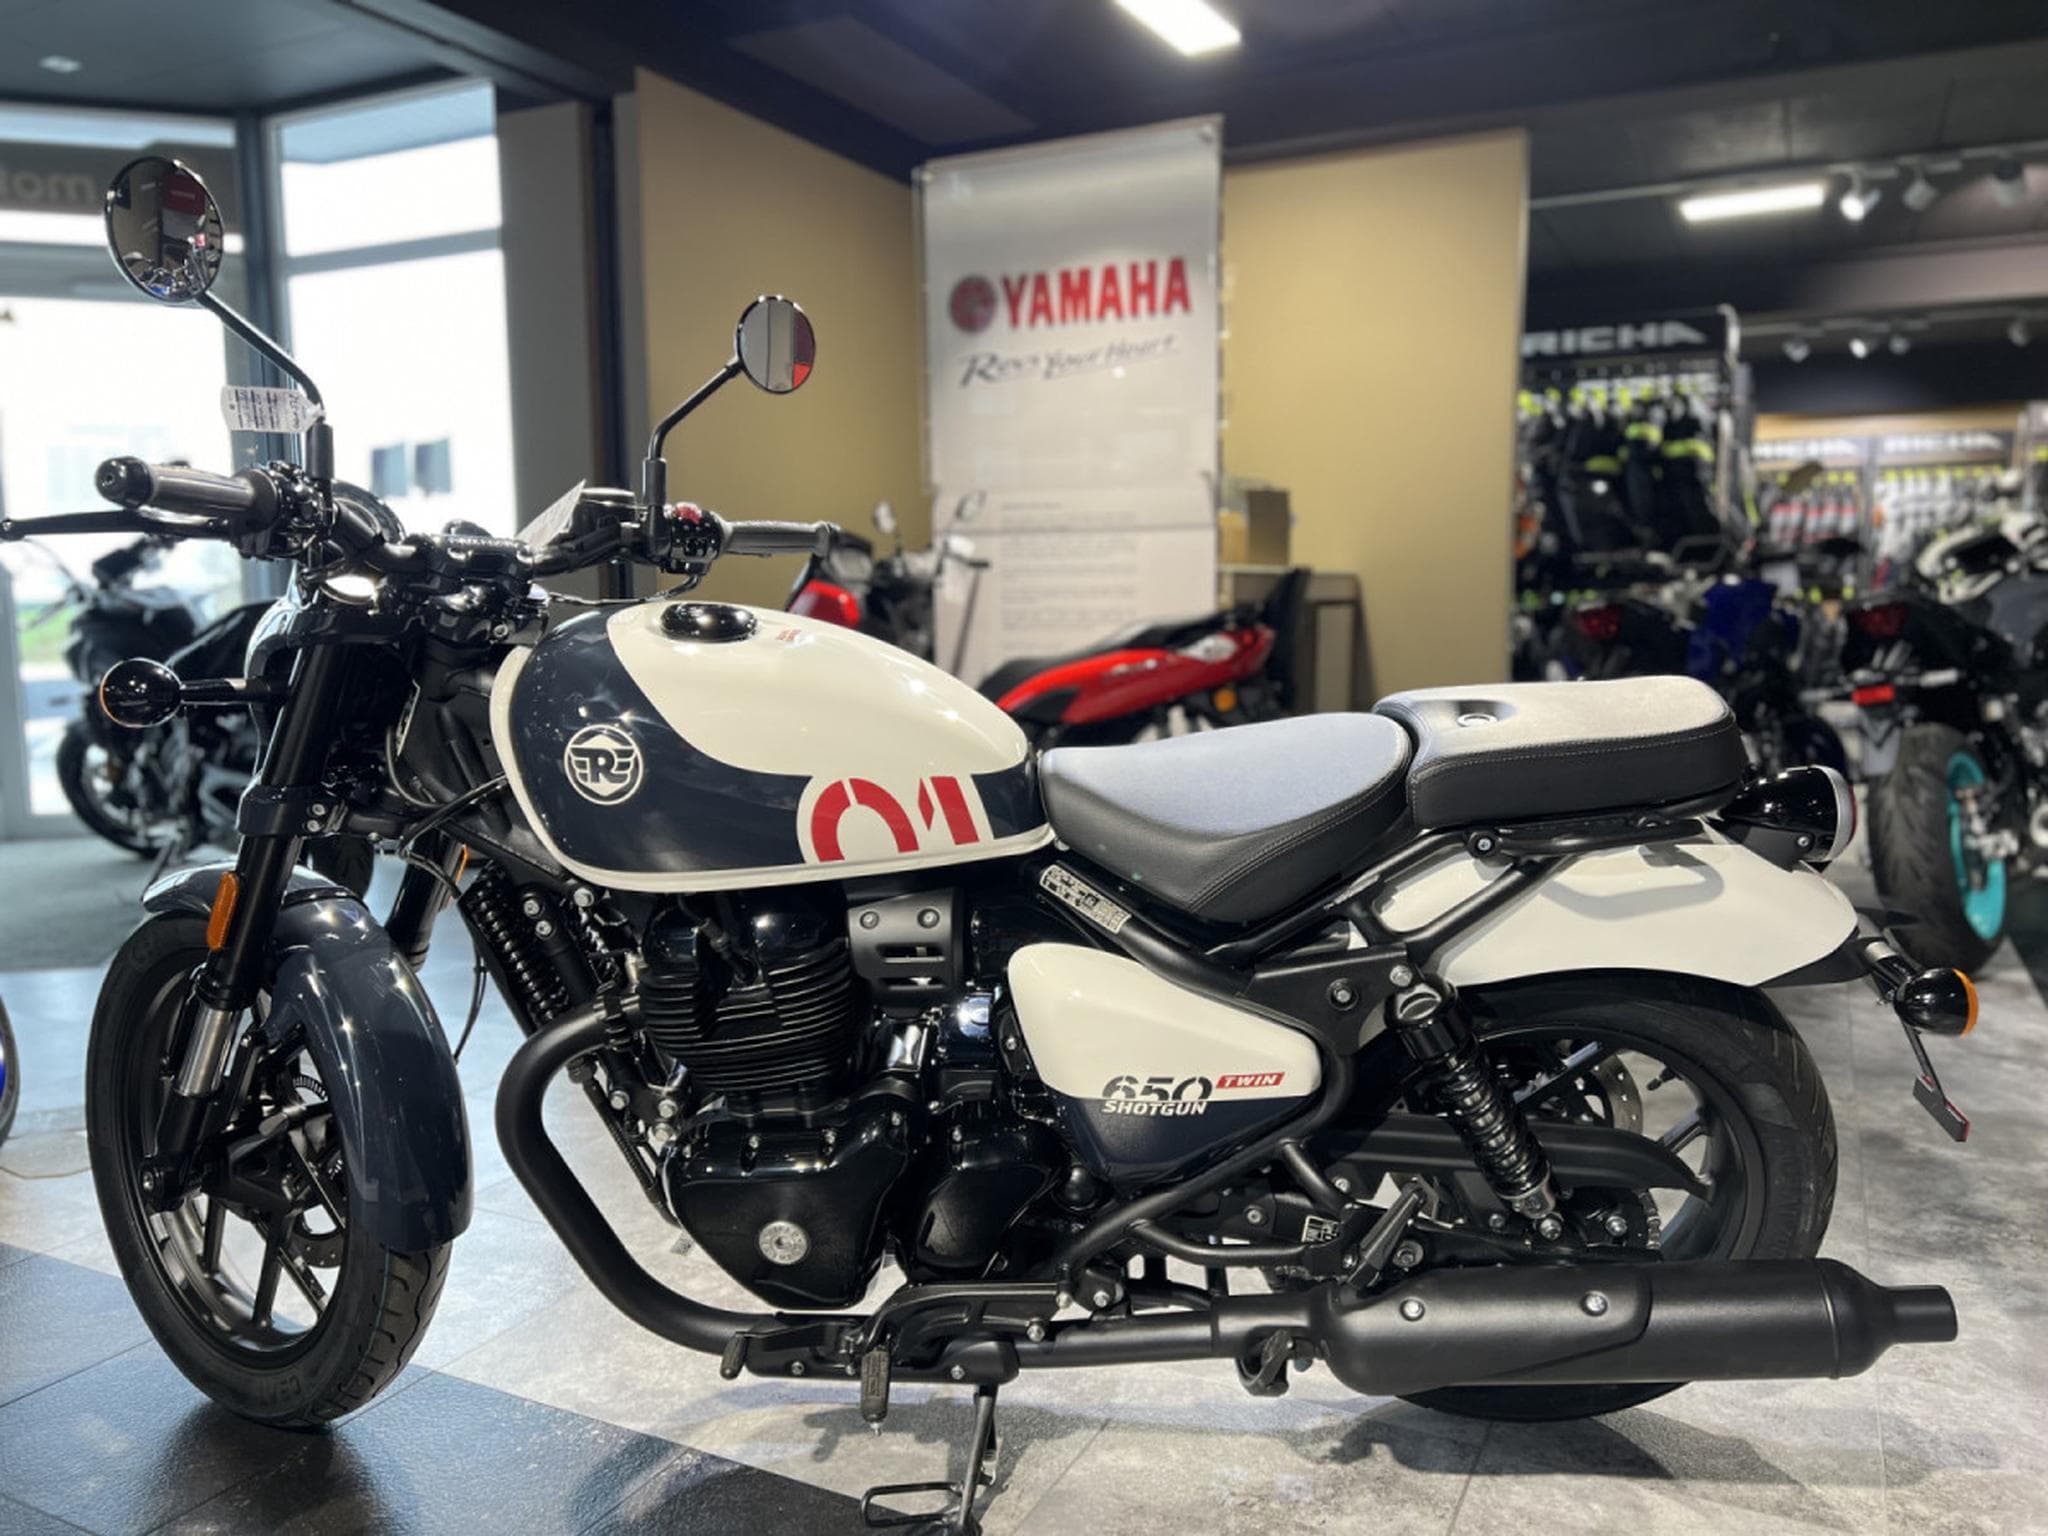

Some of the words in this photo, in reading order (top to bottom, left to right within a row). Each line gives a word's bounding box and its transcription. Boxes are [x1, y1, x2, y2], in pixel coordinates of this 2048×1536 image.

[1001, 255, 1192, 329] YAMAHA
[1521, 321, 1707, 358] RICHA
[1102, 1075, 1213, 1101] 650
[1223, 1074, 1280, 1088] TWIN
[1101, 1100, 1208, 1117] SHOTGUN
